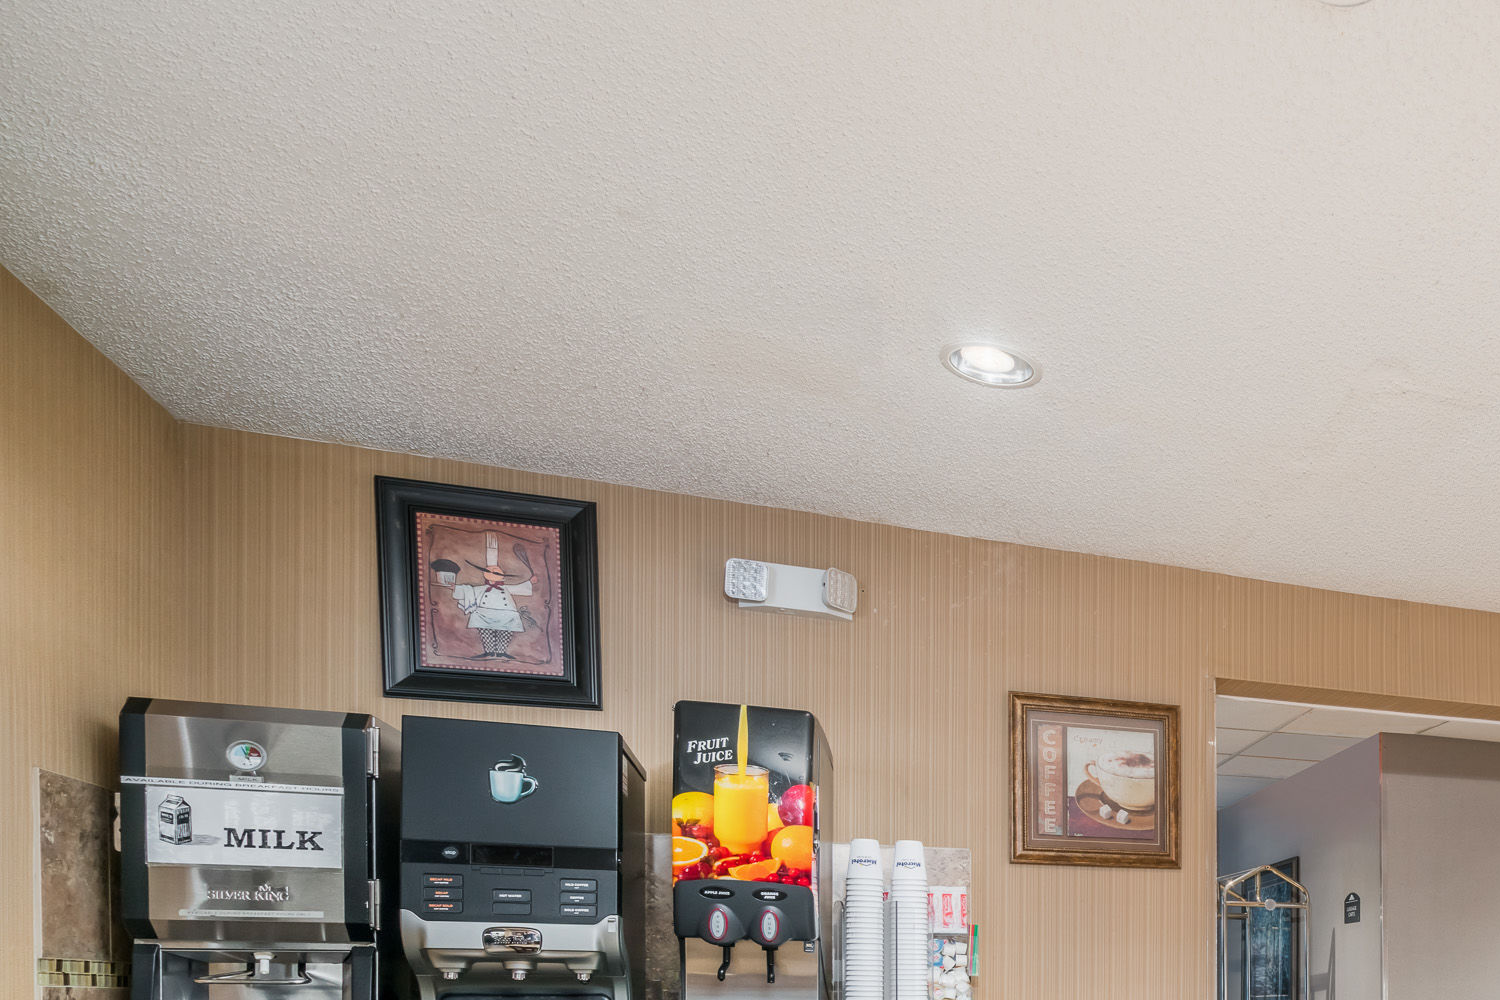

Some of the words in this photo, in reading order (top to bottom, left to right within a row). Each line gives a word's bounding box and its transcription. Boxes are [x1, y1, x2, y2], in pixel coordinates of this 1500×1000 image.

[686, 737, 729, 753] FRUIT
[693, 749, 733, 764] JUICE
[124, 777, 186, 786] AVAILABLE
[235, 782, 298, 791] BREAKFAST
[1042, 729, 1057, 833] COFFEE
[223, 827, 324, 851] MILK
[206, 889, 252, 901] SILVER
[253, 886, 290, 902] KING
